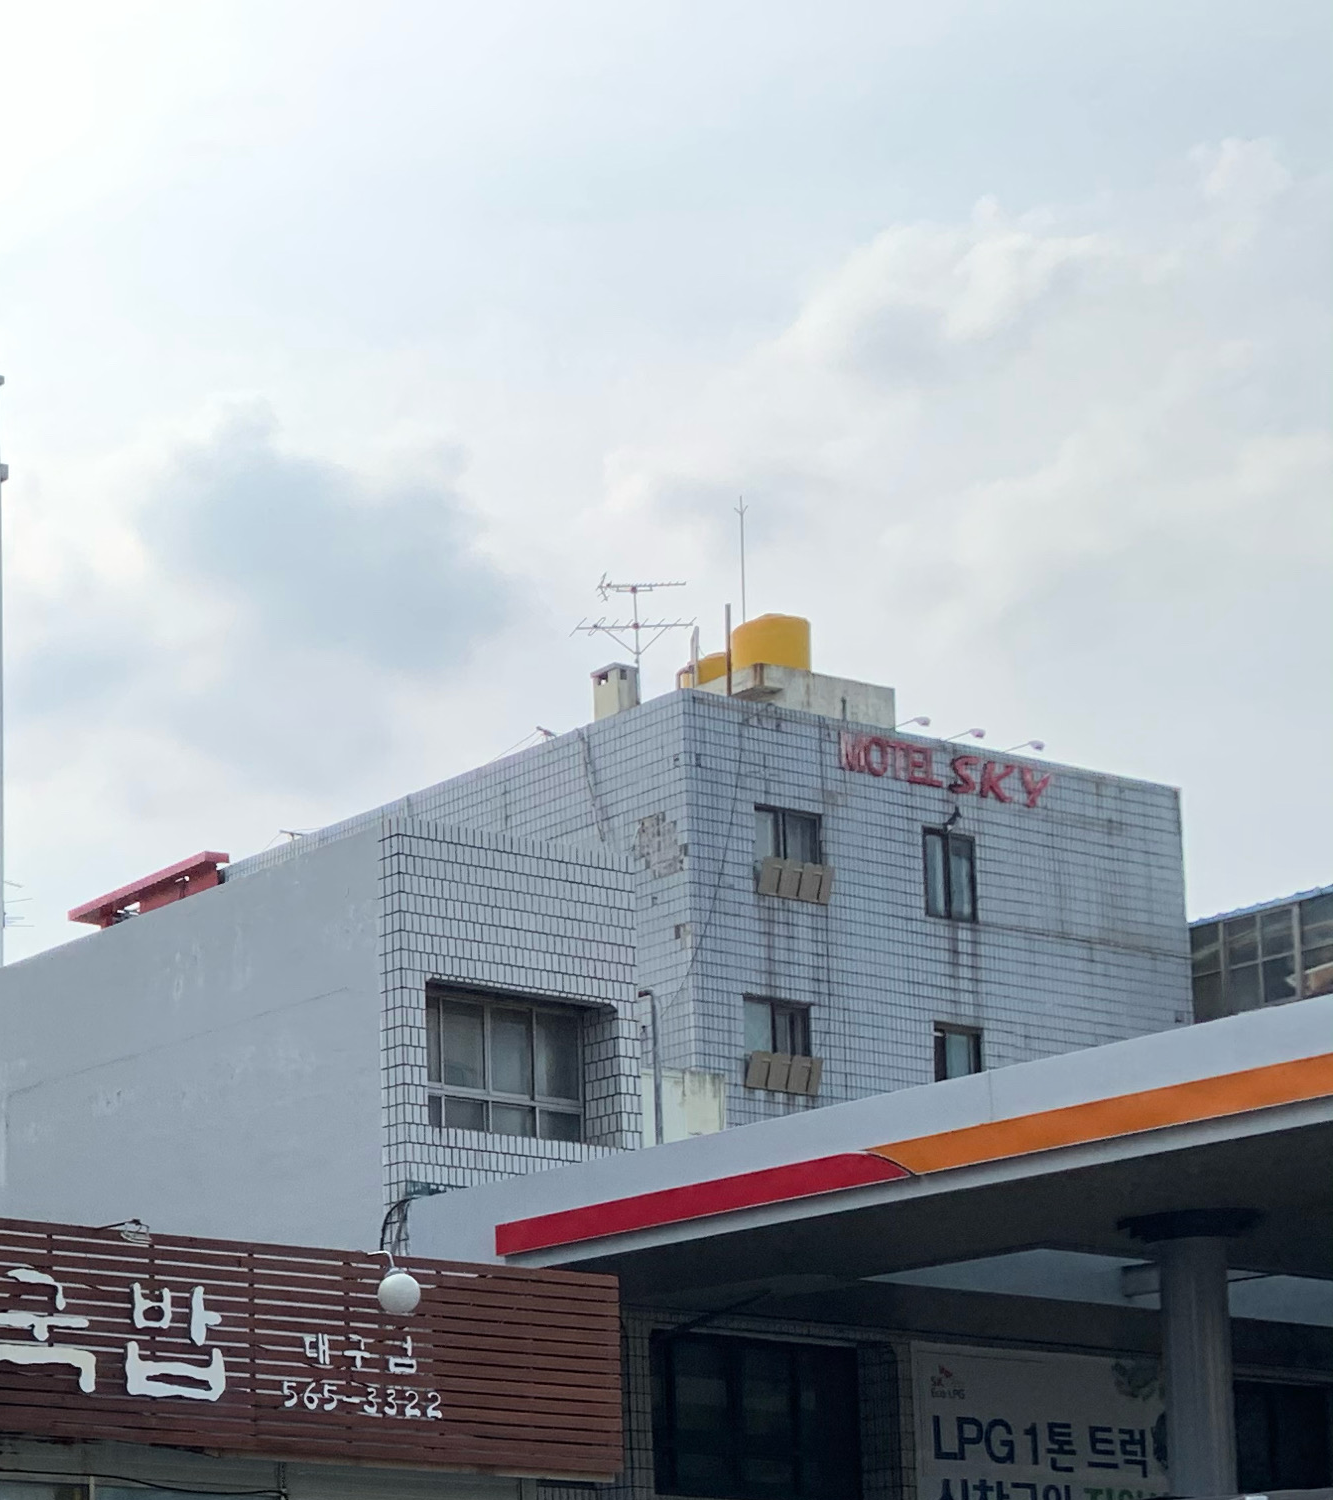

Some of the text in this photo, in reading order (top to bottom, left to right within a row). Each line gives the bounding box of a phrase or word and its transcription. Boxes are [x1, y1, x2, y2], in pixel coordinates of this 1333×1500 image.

[839, 730, 1052, 808] MOTEL SKY
[282, 1380, 443, 1419] 565-3322
[933, 1415, 1148, 1478] LPG 1톤 트럭
